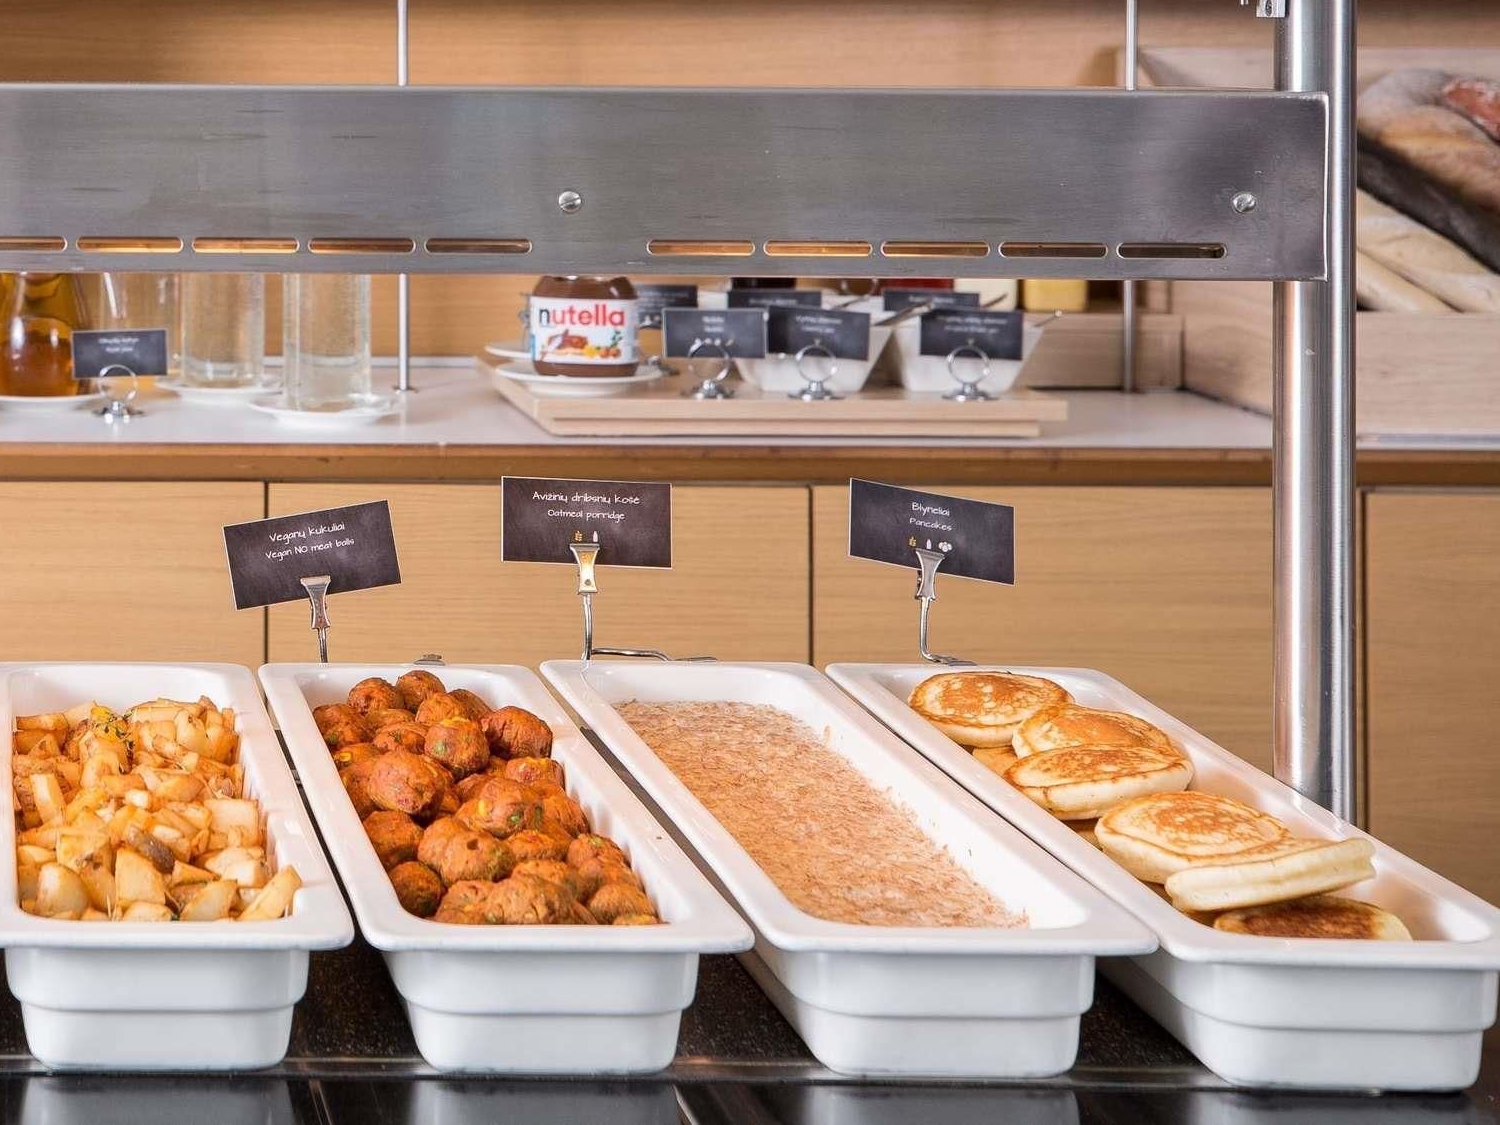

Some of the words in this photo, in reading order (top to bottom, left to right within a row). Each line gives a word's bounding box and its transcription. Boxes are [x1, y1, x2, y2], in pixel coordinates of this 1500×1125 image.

[539, 304, 626, 326] nutella
[547, 509, 583, 518] Oatmeal
[586, 510, 626, 524] porridge
[911, 501, 950, 517] Blyneliai
[307, 521, 346, 536] kukuliai
[909, 517, 953, 532] Pancakes
[265, 548, 293, 562] Vegan
[294, 545, 309, 555] NO
[310, 540, 333, 552] meat
[336, 538, 355, 548] balls
